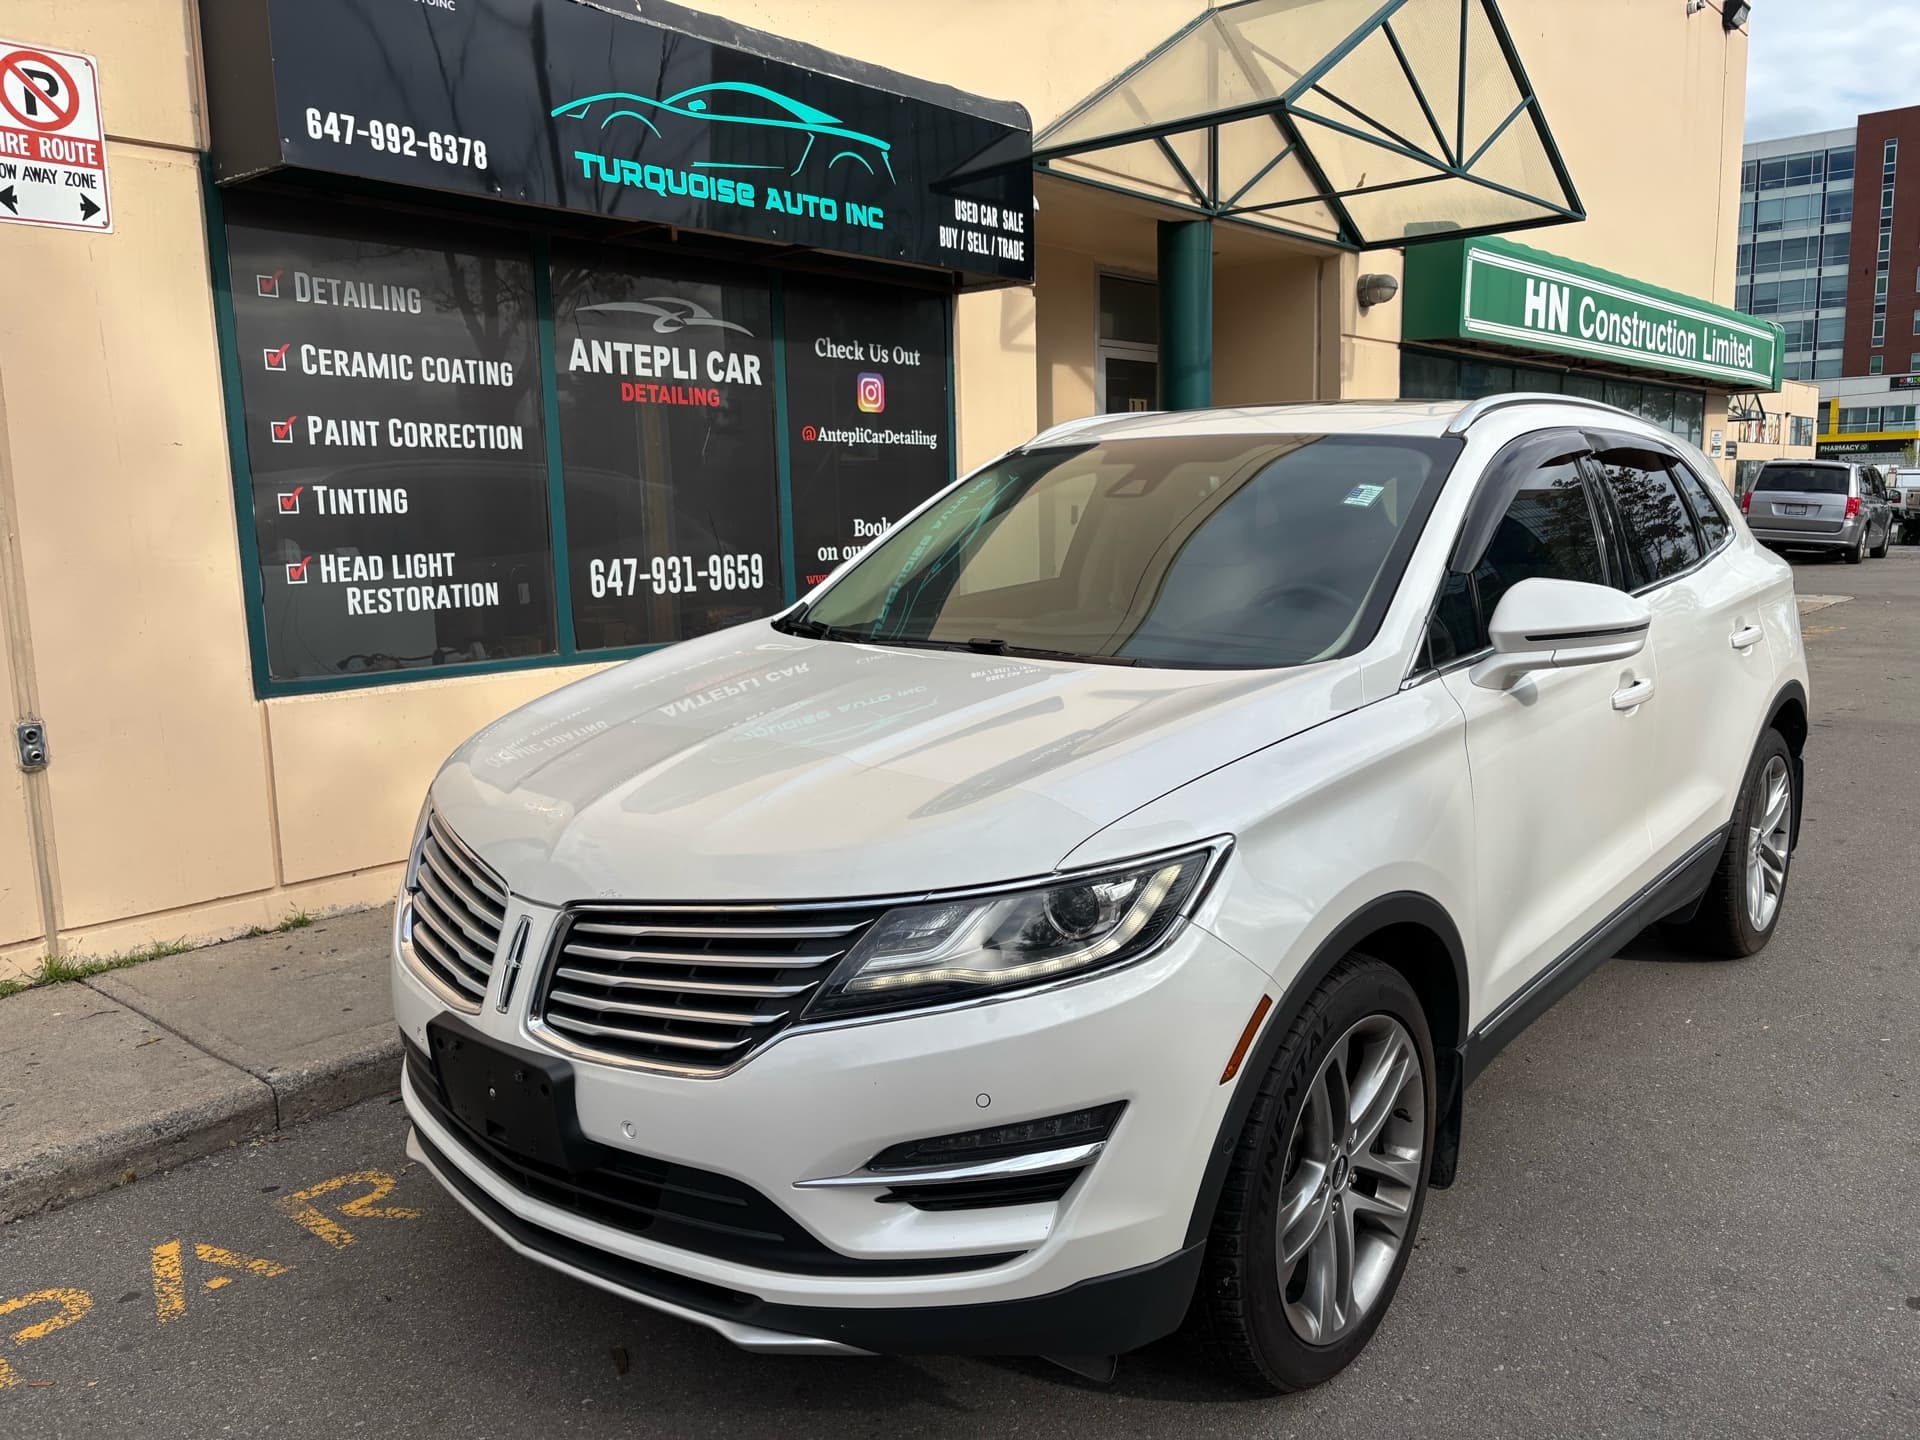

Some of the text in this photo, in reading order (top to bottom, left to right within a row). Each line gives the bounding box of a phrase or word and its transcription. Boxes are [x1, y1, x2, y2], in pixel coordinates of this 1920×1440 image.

[38, 136, 98, 165] ROUTE
[306, 107, 488, 170] 647-992-6378
[22, 166, 58, 184] AWAY
[63, 171, 97, 189] ZONE
[574, 151, 884, 230] TURQUOISE AUTO INC
[954, 198, 1024, 233] USED CAR SALE
[939, 225, 958, 249] BUY
[967, 231, 989, 255] SELL
[997, 237, 1024, 261] TRADE
[294, 271, 422, 314] DETAILING
[1524, 277, 1753, 370] HN Construction Limited
[300, 343, 514, 387] CERAMIC COATING
[568, 338, 762, 386] ANTEPLI CAR
[814, 338, 921, 366] Check Us Out
[620, 382, 721, 408] DETAILING
[307, 416, 524, 450] PAINT CORRECTION
[801, 425, 938, 449] @AntepliCarDetailing
[1820, 444, 1859, 452] PHARMACY
[312, 485, 408, 515] TINTING
[319, 552, 455, 584] HEAD LIGHT
[817, 545, 868, 561] on ou
[590, 553, 764, 598] 647-931-9659
[346, 582, 499, 615] RESTORATION
